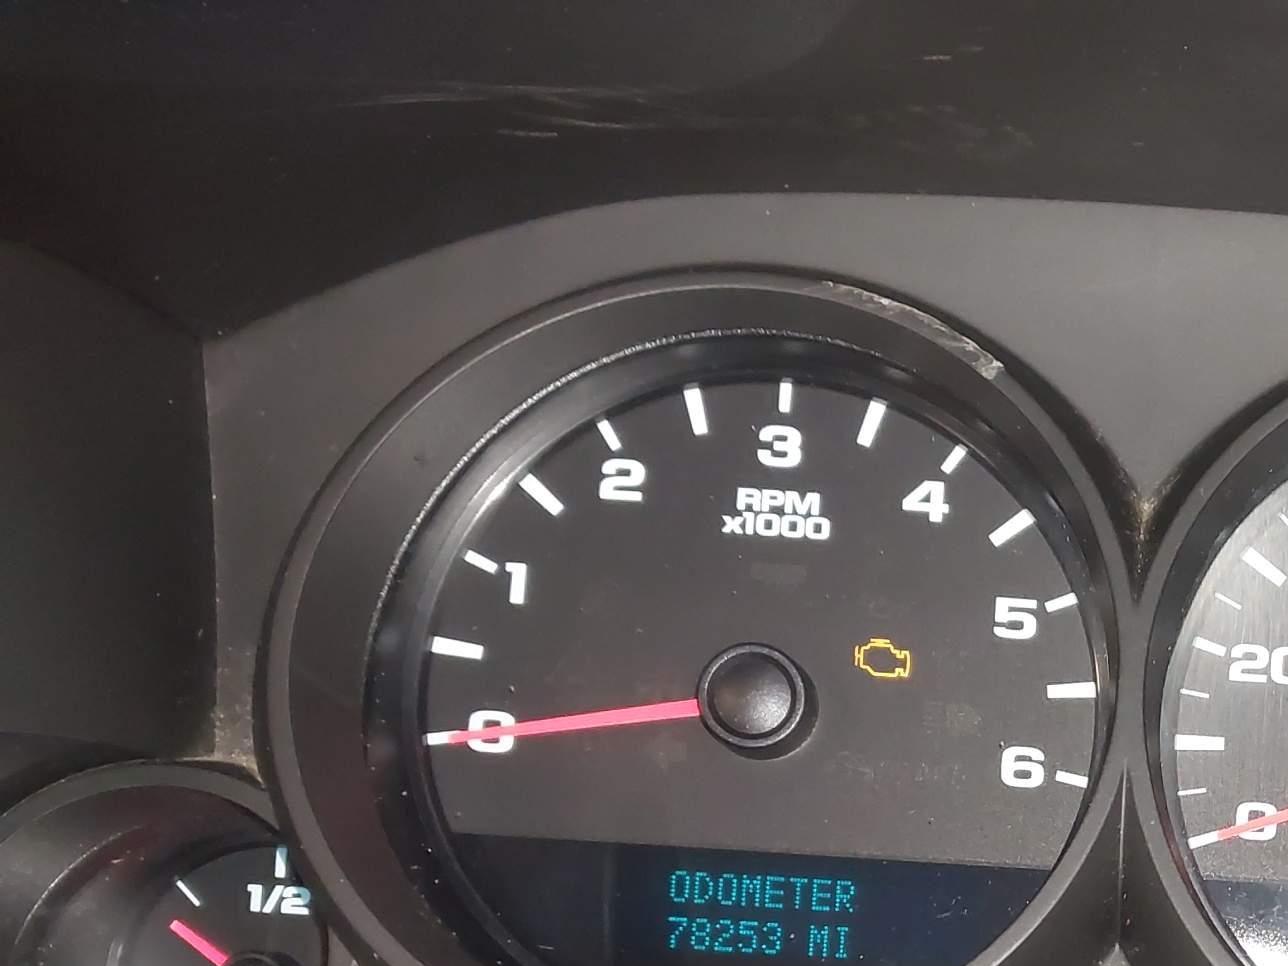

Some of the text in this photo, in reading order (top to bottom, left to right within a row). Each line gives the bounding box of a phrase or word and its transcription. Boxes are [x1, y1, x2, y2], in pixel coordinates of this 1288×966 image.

[757, 424, 803, 468] 3
[598, 458, 647, 502] 2
[735, 486, 821, 513] RPM
[901, 480, 951, 523] 4
[720, 511, 832, 541] x1000
[505, 561, 528, 605] 1
[992, 596, 1039, 640] 5
[466, 709, 516, 754] 0
[998, 745, 1046, 789] 6
[1235, 802, 1277, 841] 0
[247, 883, 312, 915] 1/2
[669, 870, 856, 913] ODOMETER
[668, 916, 849, 959] 78253 MI
